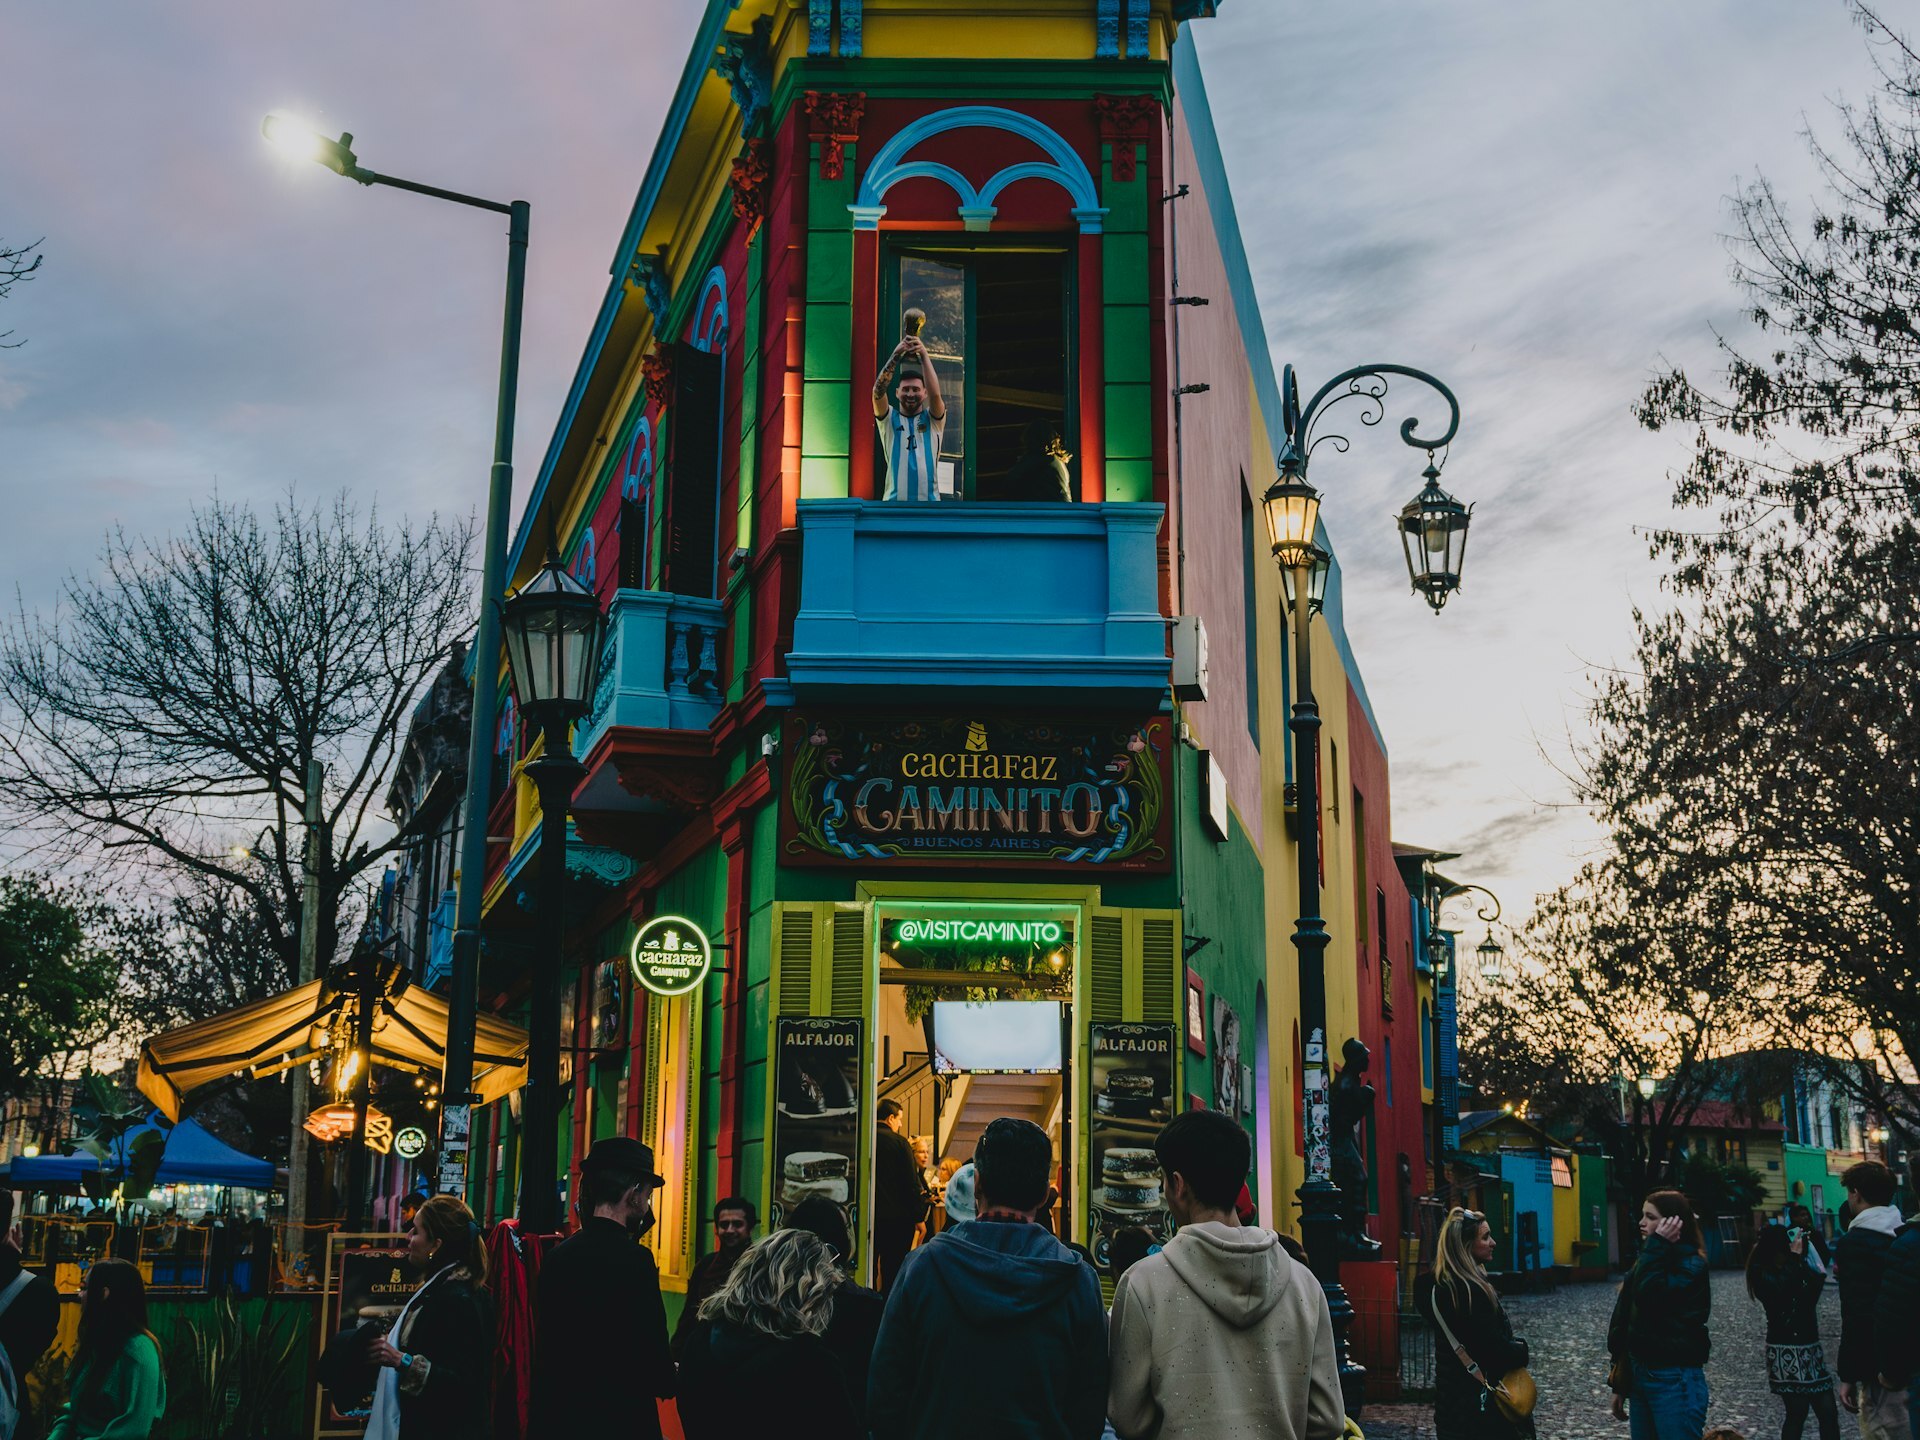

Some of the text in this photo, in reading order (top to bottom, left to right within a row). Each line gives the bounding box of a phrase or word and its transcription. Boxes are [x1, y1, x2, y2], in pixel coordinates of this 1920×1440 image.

[854, 777, 1102, 838] CAMINITO
[913, 837, 1041, 849] BUENOS AIRES
[900, 920, 1060, 942] @VISITCAMINITO
[649, 965, 690, 978] CAMINITO
[785, 1033, 855, 1046] ALFAJOR
[1099, 1038, 1168, 1052] ALFAJOR
